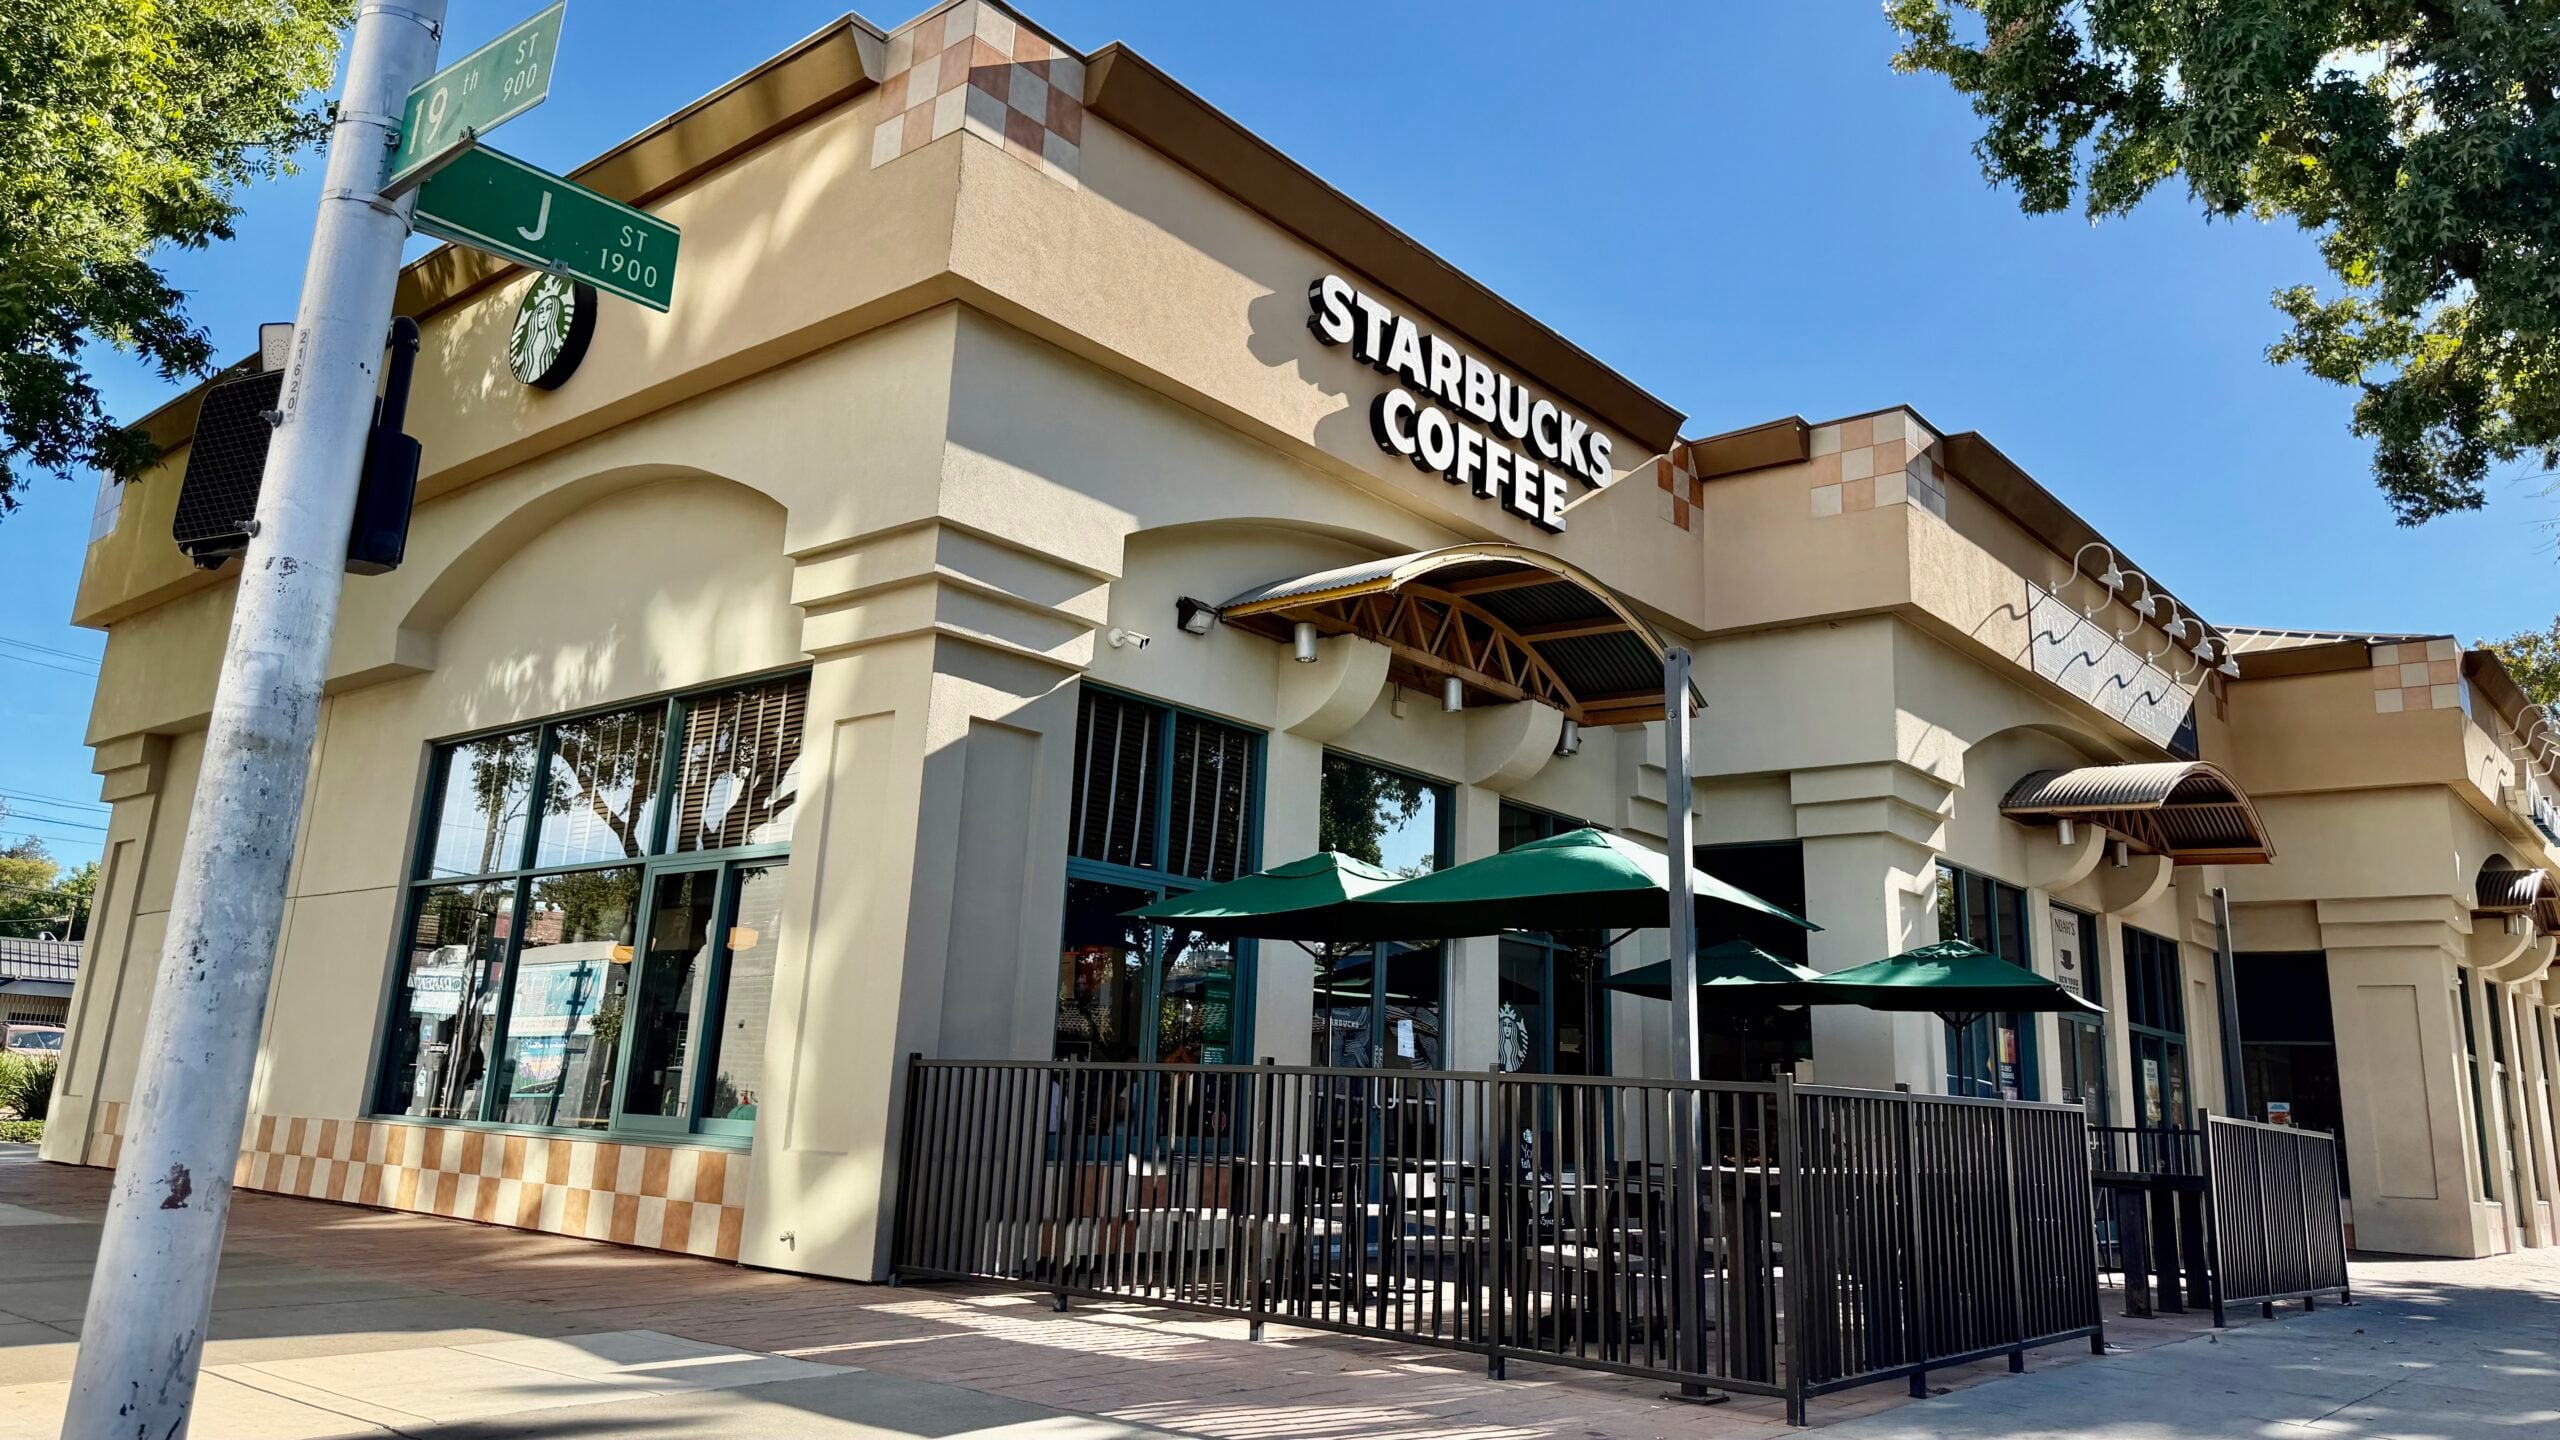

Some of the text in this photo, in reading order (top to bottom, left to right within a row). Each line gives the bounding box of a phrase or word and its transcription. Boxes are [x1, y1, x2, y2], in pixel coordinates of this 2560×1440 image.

[408, 86, 449, 156] 19
[515, 31, 540, 65] ST
[502, 63, 538, 103] 900
[516, 190, 649, 253] J ST
[600, 248, 658, 289] 1900
[287, 331, 308, 410] 21620
[1310, 273, 1614, 489] STARBUCKS
[1374, 387, 1568, 533] COFFEE
